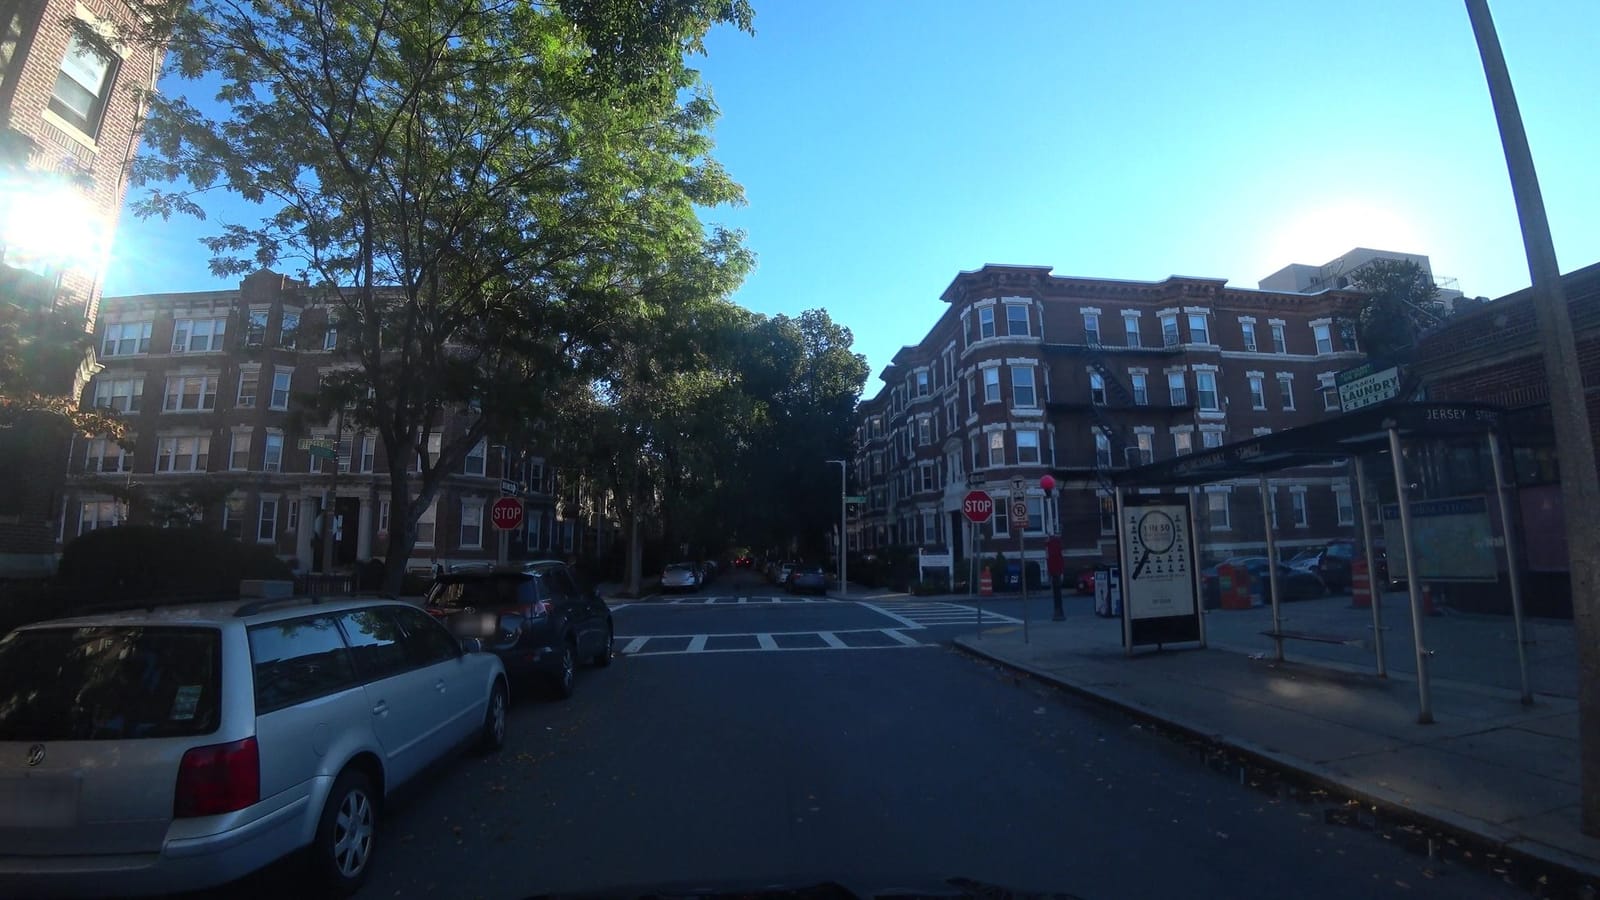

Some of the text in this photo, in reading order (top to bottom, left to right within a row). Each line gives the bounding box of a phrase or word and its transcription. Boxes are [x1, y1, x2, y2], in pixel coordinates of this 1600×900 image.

[1342, 376, 1397, 402] LAUNDRY
[1426, 408, 1466, 420] JERSEY
[964, 499, 991, 513] STOP
[494, 507, 522, 520] STOP
